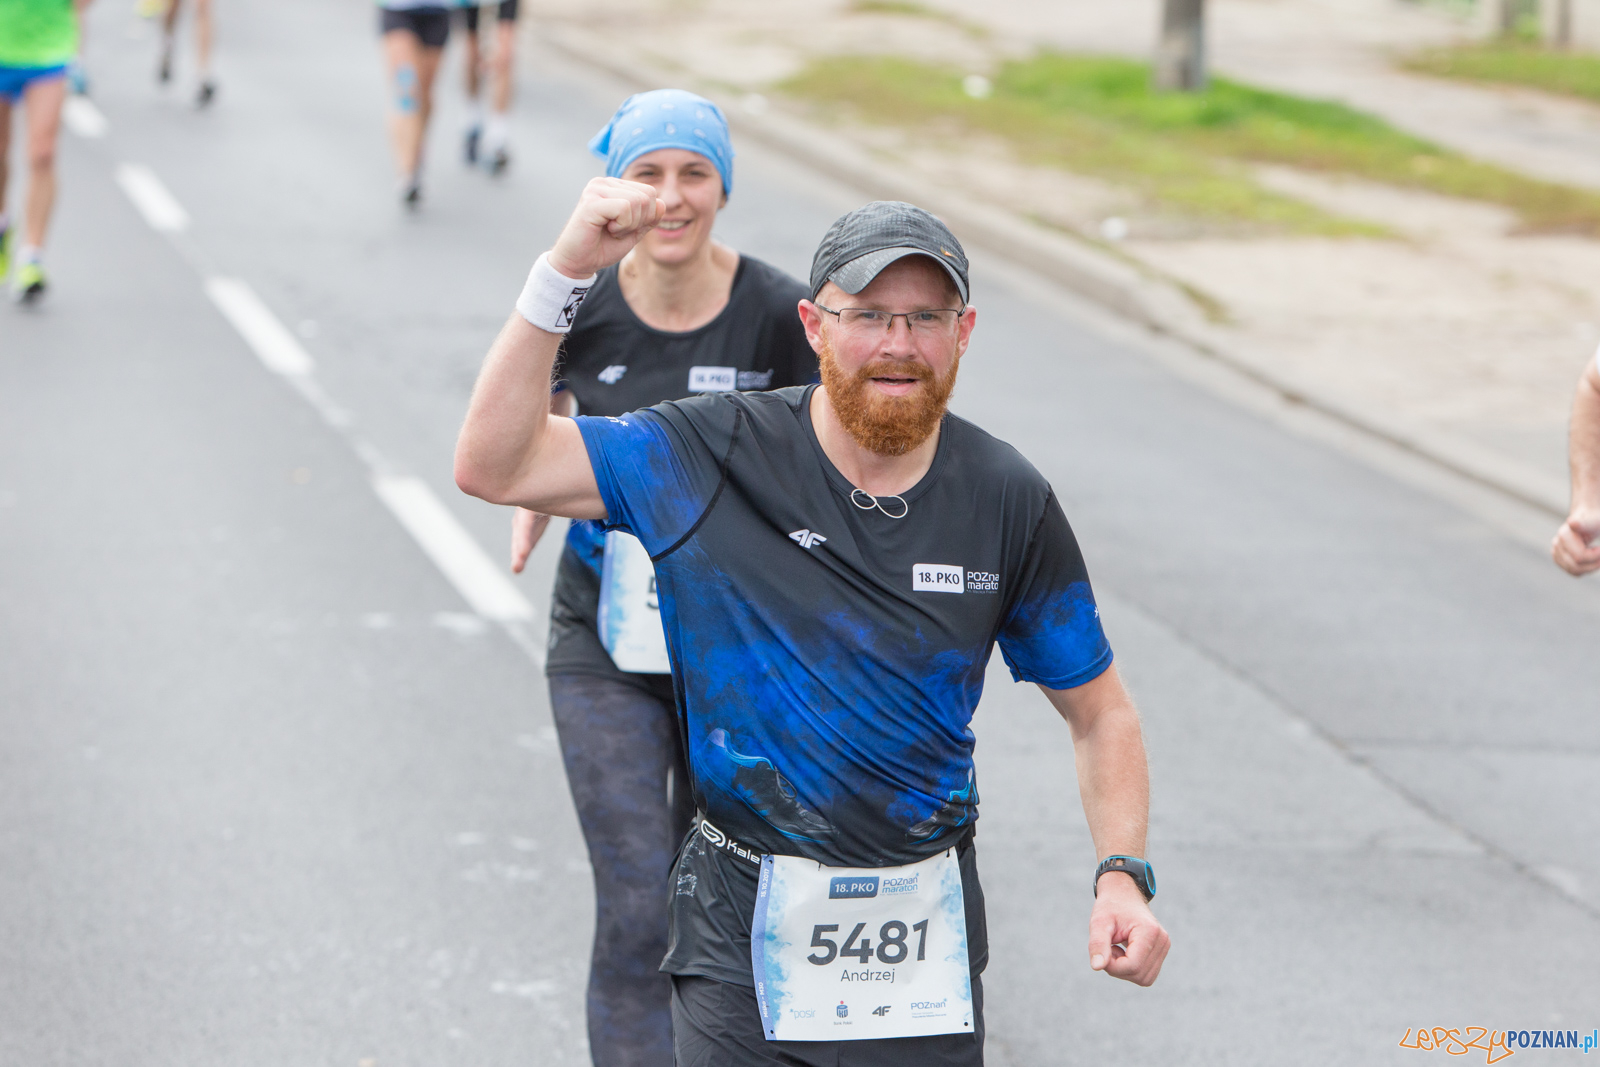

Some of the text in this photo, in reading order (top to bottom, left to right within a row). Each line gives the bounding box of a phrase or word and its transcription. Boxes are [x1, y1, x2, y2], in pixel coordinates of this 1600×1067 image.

[788, 528, 827, 549] 4F
[918, 572, 960, 585] 18. PKO
[761, 868, 770, 898] 15.10.2017
[834, 882, 875, 893] 18. PKO
[881, 883, 918, 893] maraton
[806, 918, 929, 966] 5481
[840, 968, 896, 984] Andrzej
[872, 1006, 892, 1017] 4F
